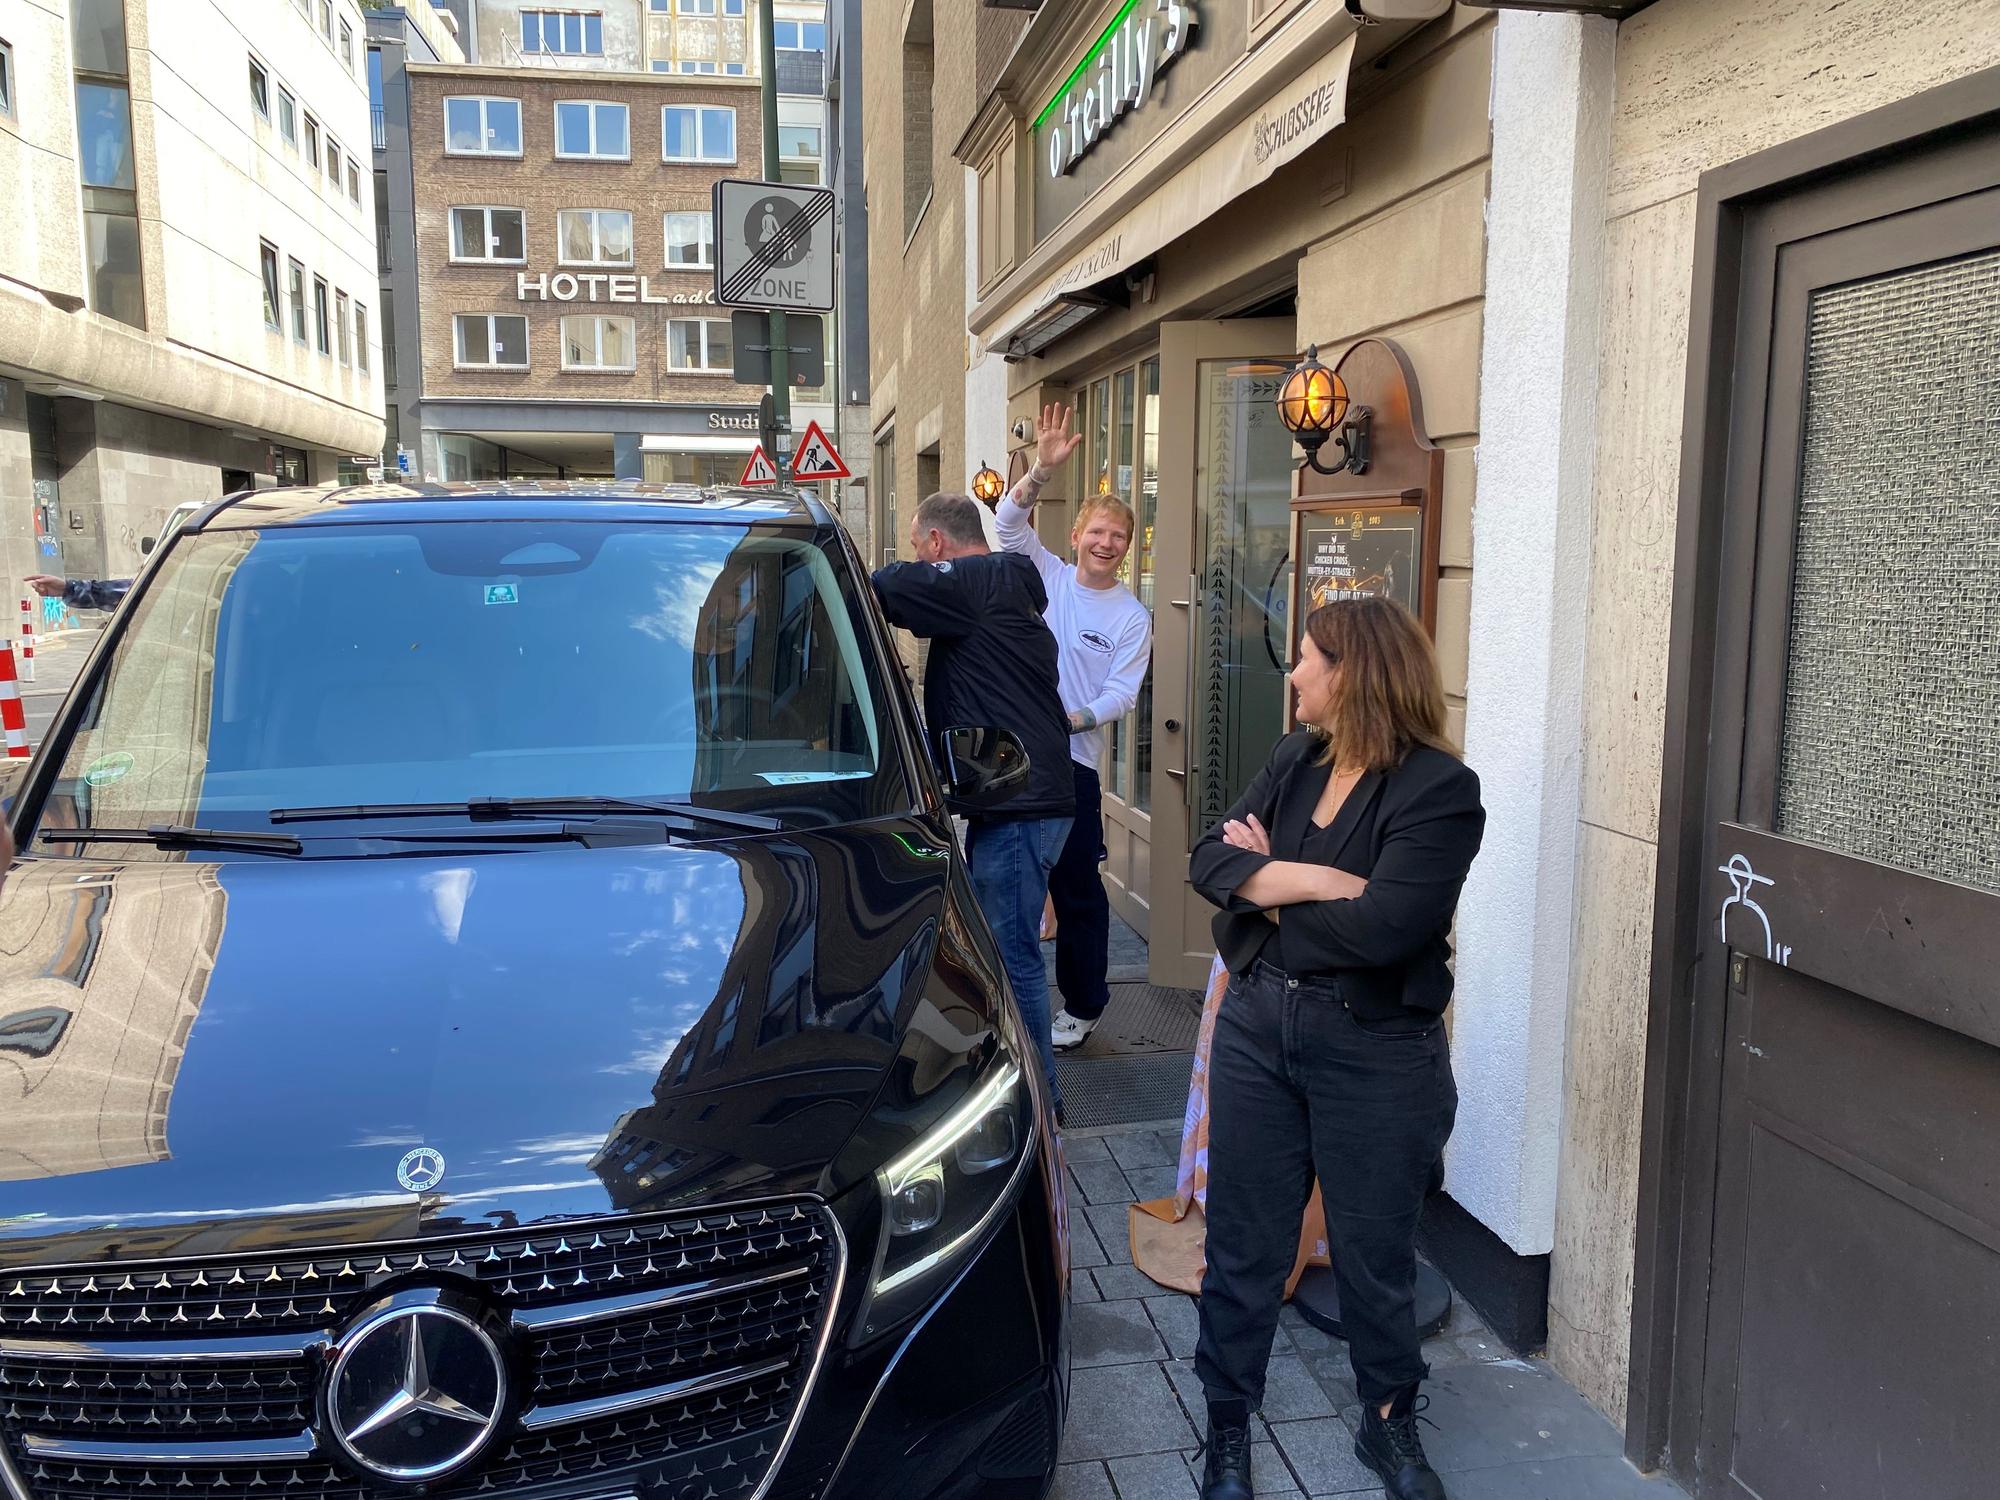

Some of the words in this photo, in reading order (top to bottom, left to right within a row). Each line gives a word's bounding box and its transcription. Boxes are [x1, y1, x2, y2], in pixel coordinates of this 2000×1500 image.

[517, 272, 668, 303] HOTEL
[750, 278, 807, 300] ZONE
[1337, 544, 1346, 554] THE
[1324, 589, 1338, 601] FIND
[1339, 590, 1351, 601] OUT
[1352, 591, 1361, 601] AT
